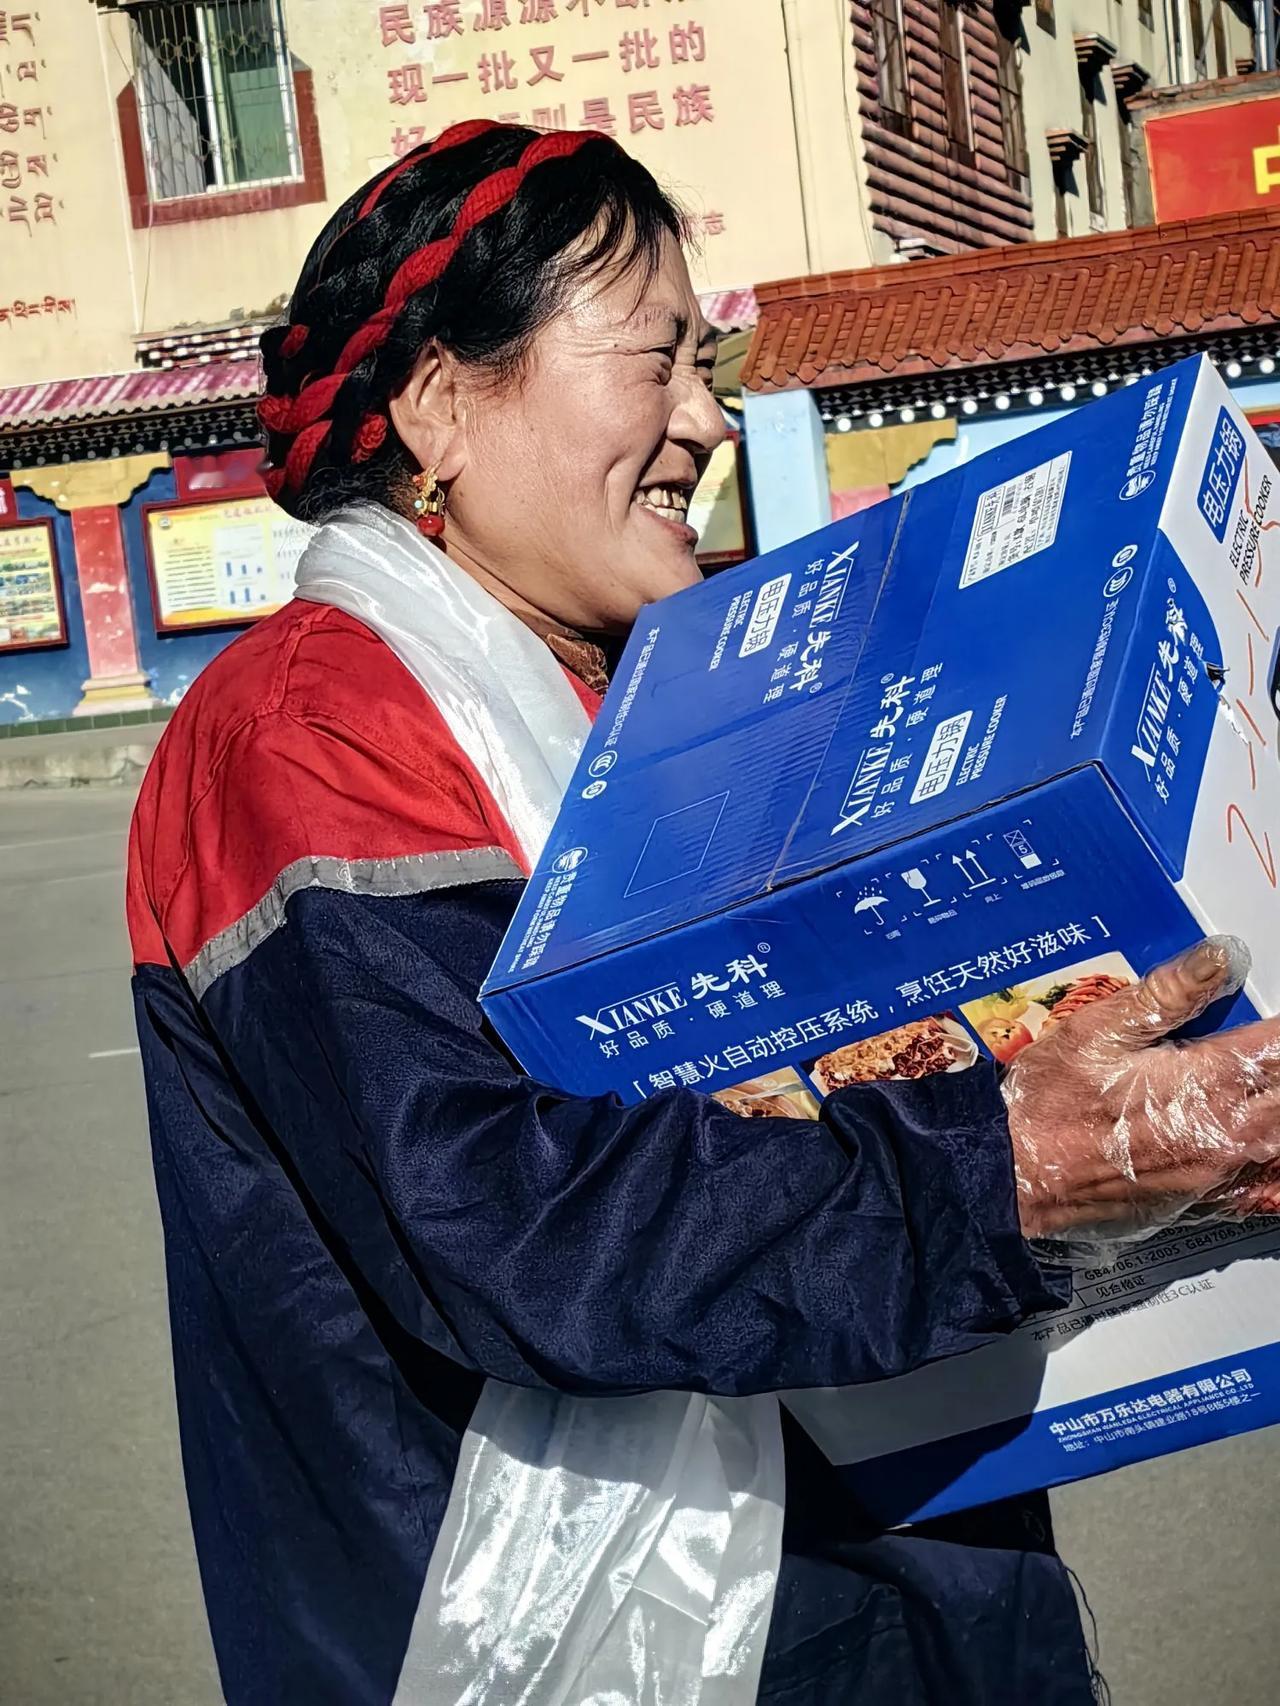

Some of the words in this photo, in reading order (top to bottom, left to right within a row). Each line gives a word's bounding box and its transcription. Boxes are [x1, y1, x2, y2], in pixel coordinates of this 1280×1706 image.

[378, 0, 690, 47] 民族源源
[387, 20, 707, 106] 现一批又一批的
[391, 83, 716, 158] 好则是民族
[1203, 417, 1242, 528] 电压力锅
[1229, 509, 1249, 569] ELECTRIC
[1239, 521, 1260, 585] PRESSURE
[1254, 474, 1273, 526] COOKER
[721, 595, 741, 637] PRESSURE
[733, 590, 753, 628] ELECTRIC
[746, 579, 785, 653] 电压力锅
[809, 541, 860, 630] XIANKE
[709, 636, 728, 671] COOKER
[970, 733, 991, 781] PRESSURE
[987, 694, 1008, 733] COOKER
[1130, 662, 1171, 782] XIANKE
[830, 742, 893, 836] XIANKE
[918, 717, 967, 797] 电压力锅
[955, 743, 979, 786] ELECTRIC
[1018, 844, 1028, 854] 5
[575, 981, 688, 1040] XIANKE
[1096, 1275, 1146, 1298] 见合格证
[1049, 1368, 1252, 1436] 中山市万乐达电器有限公司
[1139, 1403, 1182, 1421] ELECTRICAL
[1184, 1391, 1225, 1408] APPLIANCE
